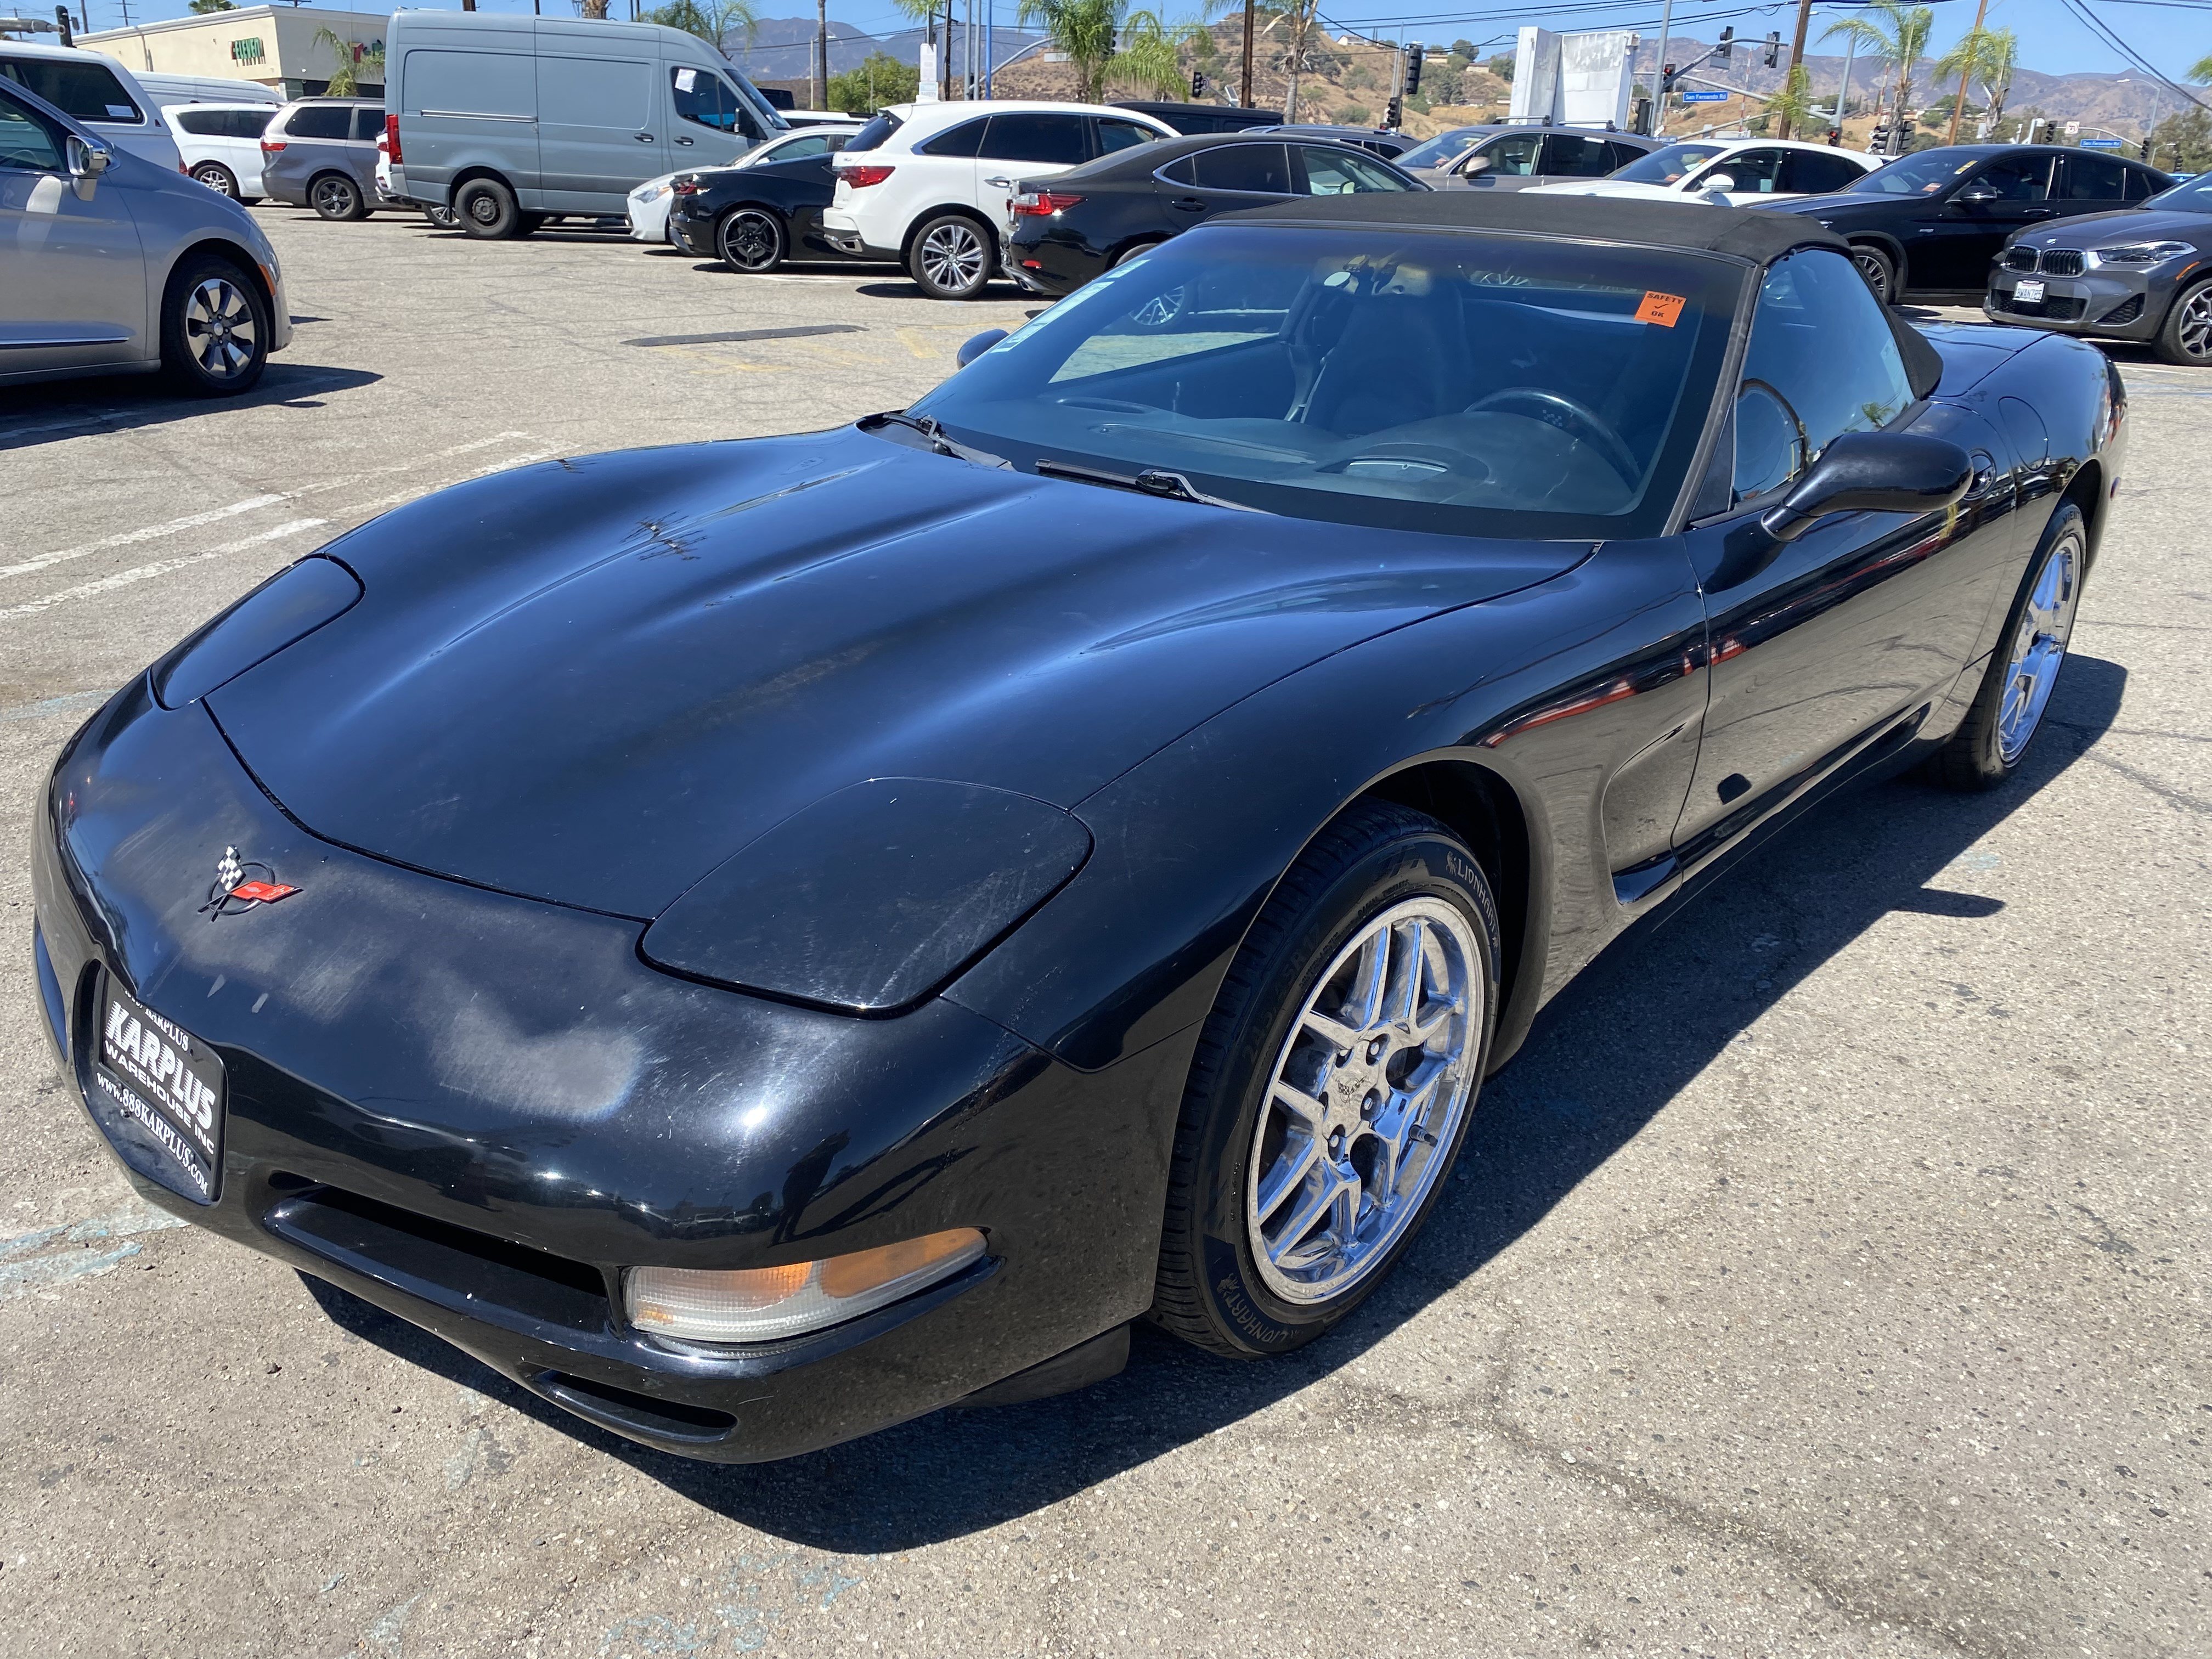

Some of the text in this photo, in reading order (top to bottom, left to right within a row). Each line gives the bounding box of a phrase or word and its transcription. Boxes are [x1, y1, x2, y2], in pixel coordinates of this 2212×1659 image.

[1647, 293, 1683, 303] SAFETY
[1457, 858, 1496, 933] LIONHART
[105, 1001, 216, 1130] KARPLUS
[105, 1040, 215, 1155] WAREHOUSE INC
[97, 1072, 208, 1195] www.888KARPLUS.COM
[1224, 1293, 1290, 1344] LIONHART
